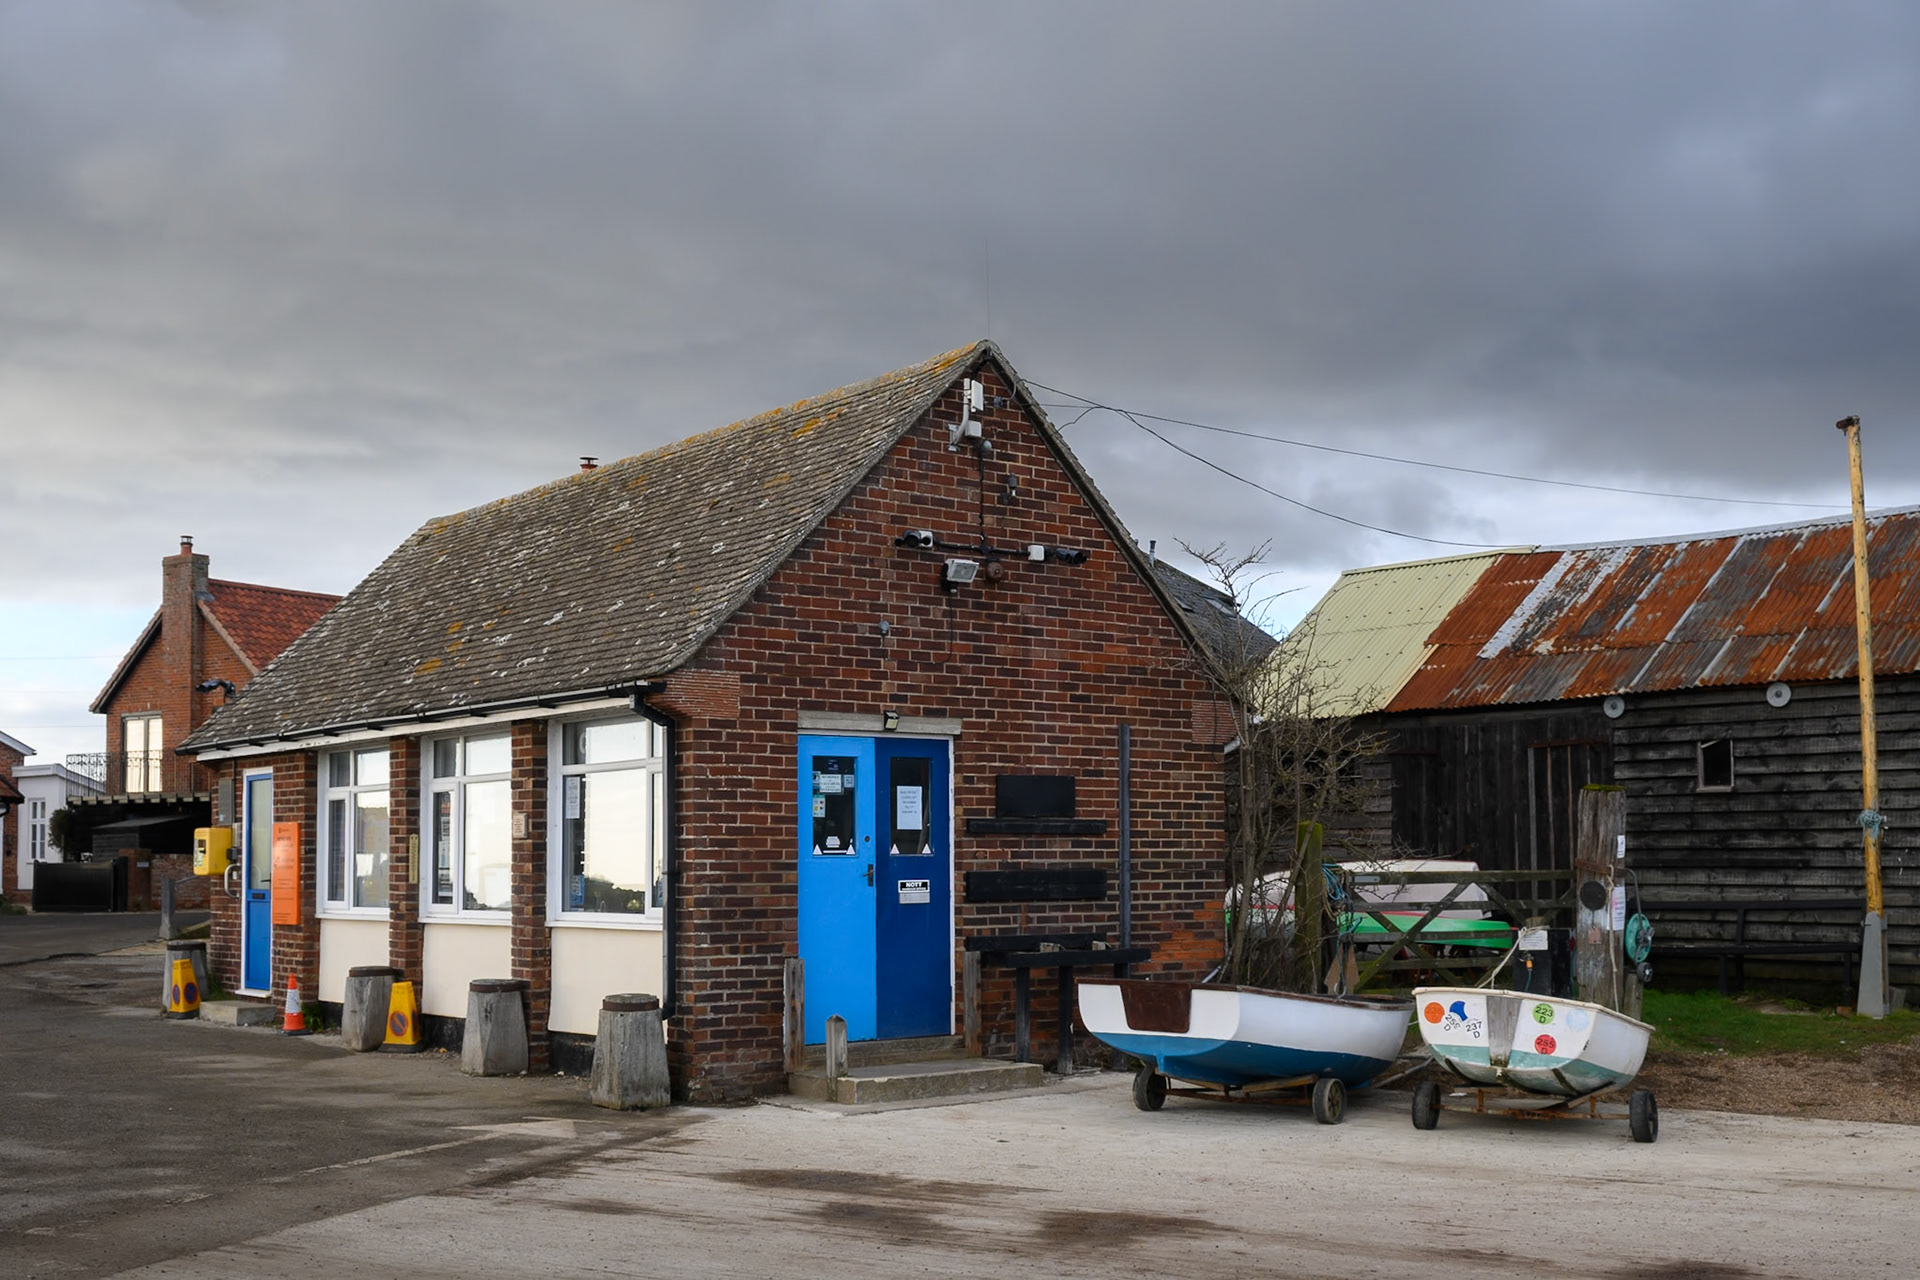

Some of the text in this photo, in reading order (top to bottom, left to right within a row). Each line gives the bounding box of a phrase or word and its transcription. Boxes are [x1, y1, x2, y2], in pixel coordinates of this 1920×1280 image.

[1535, 1006, 1554, 1017] 223
[1539, 1015, 1546, 1024] D
[1443, 1023, 1452, 1031] D
[1465, 1021, 1482, 1032] 237
[1473, 1030, 1481, 1039] D
[1536, 1038, 1555, 1049] 255
